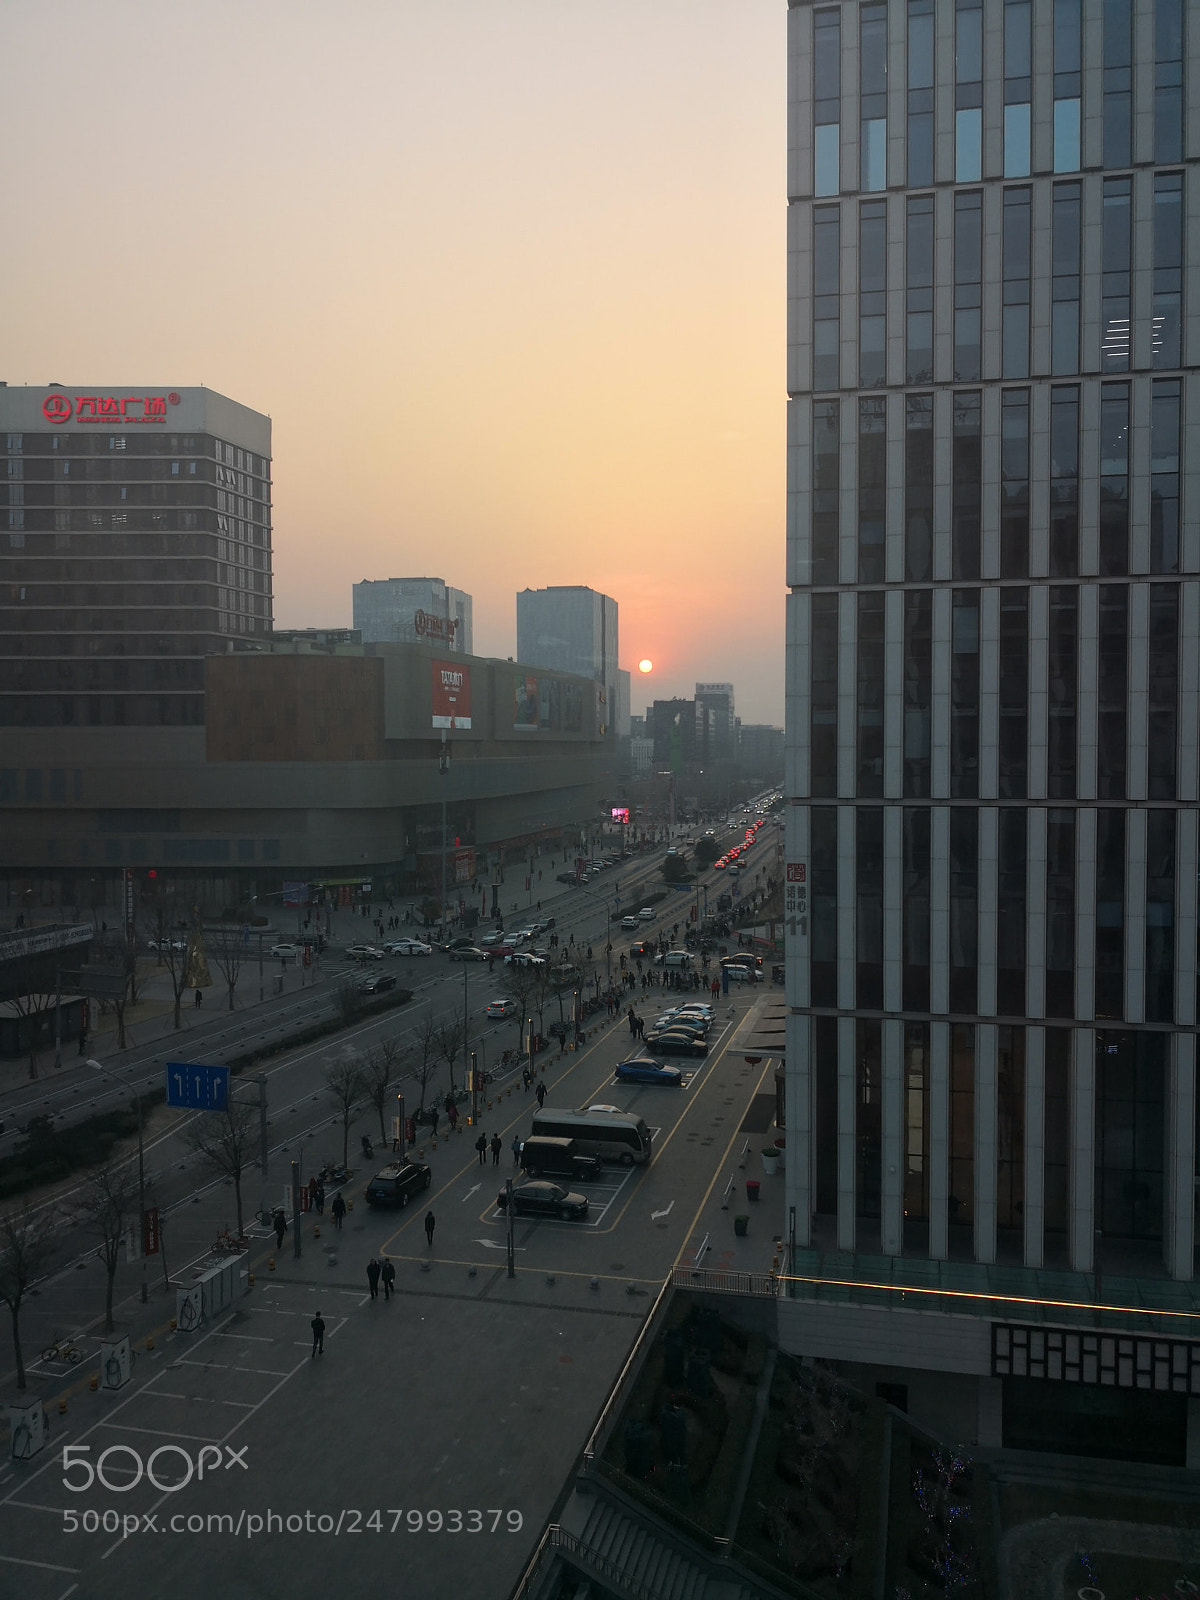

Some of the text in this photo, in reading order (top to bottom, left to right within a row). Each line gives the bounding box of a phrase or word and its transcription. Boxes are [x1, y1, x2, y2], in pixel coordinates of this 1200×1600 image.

[75, 396, 166, 415] 万达广场
[785, 915, 808, 936] 11
